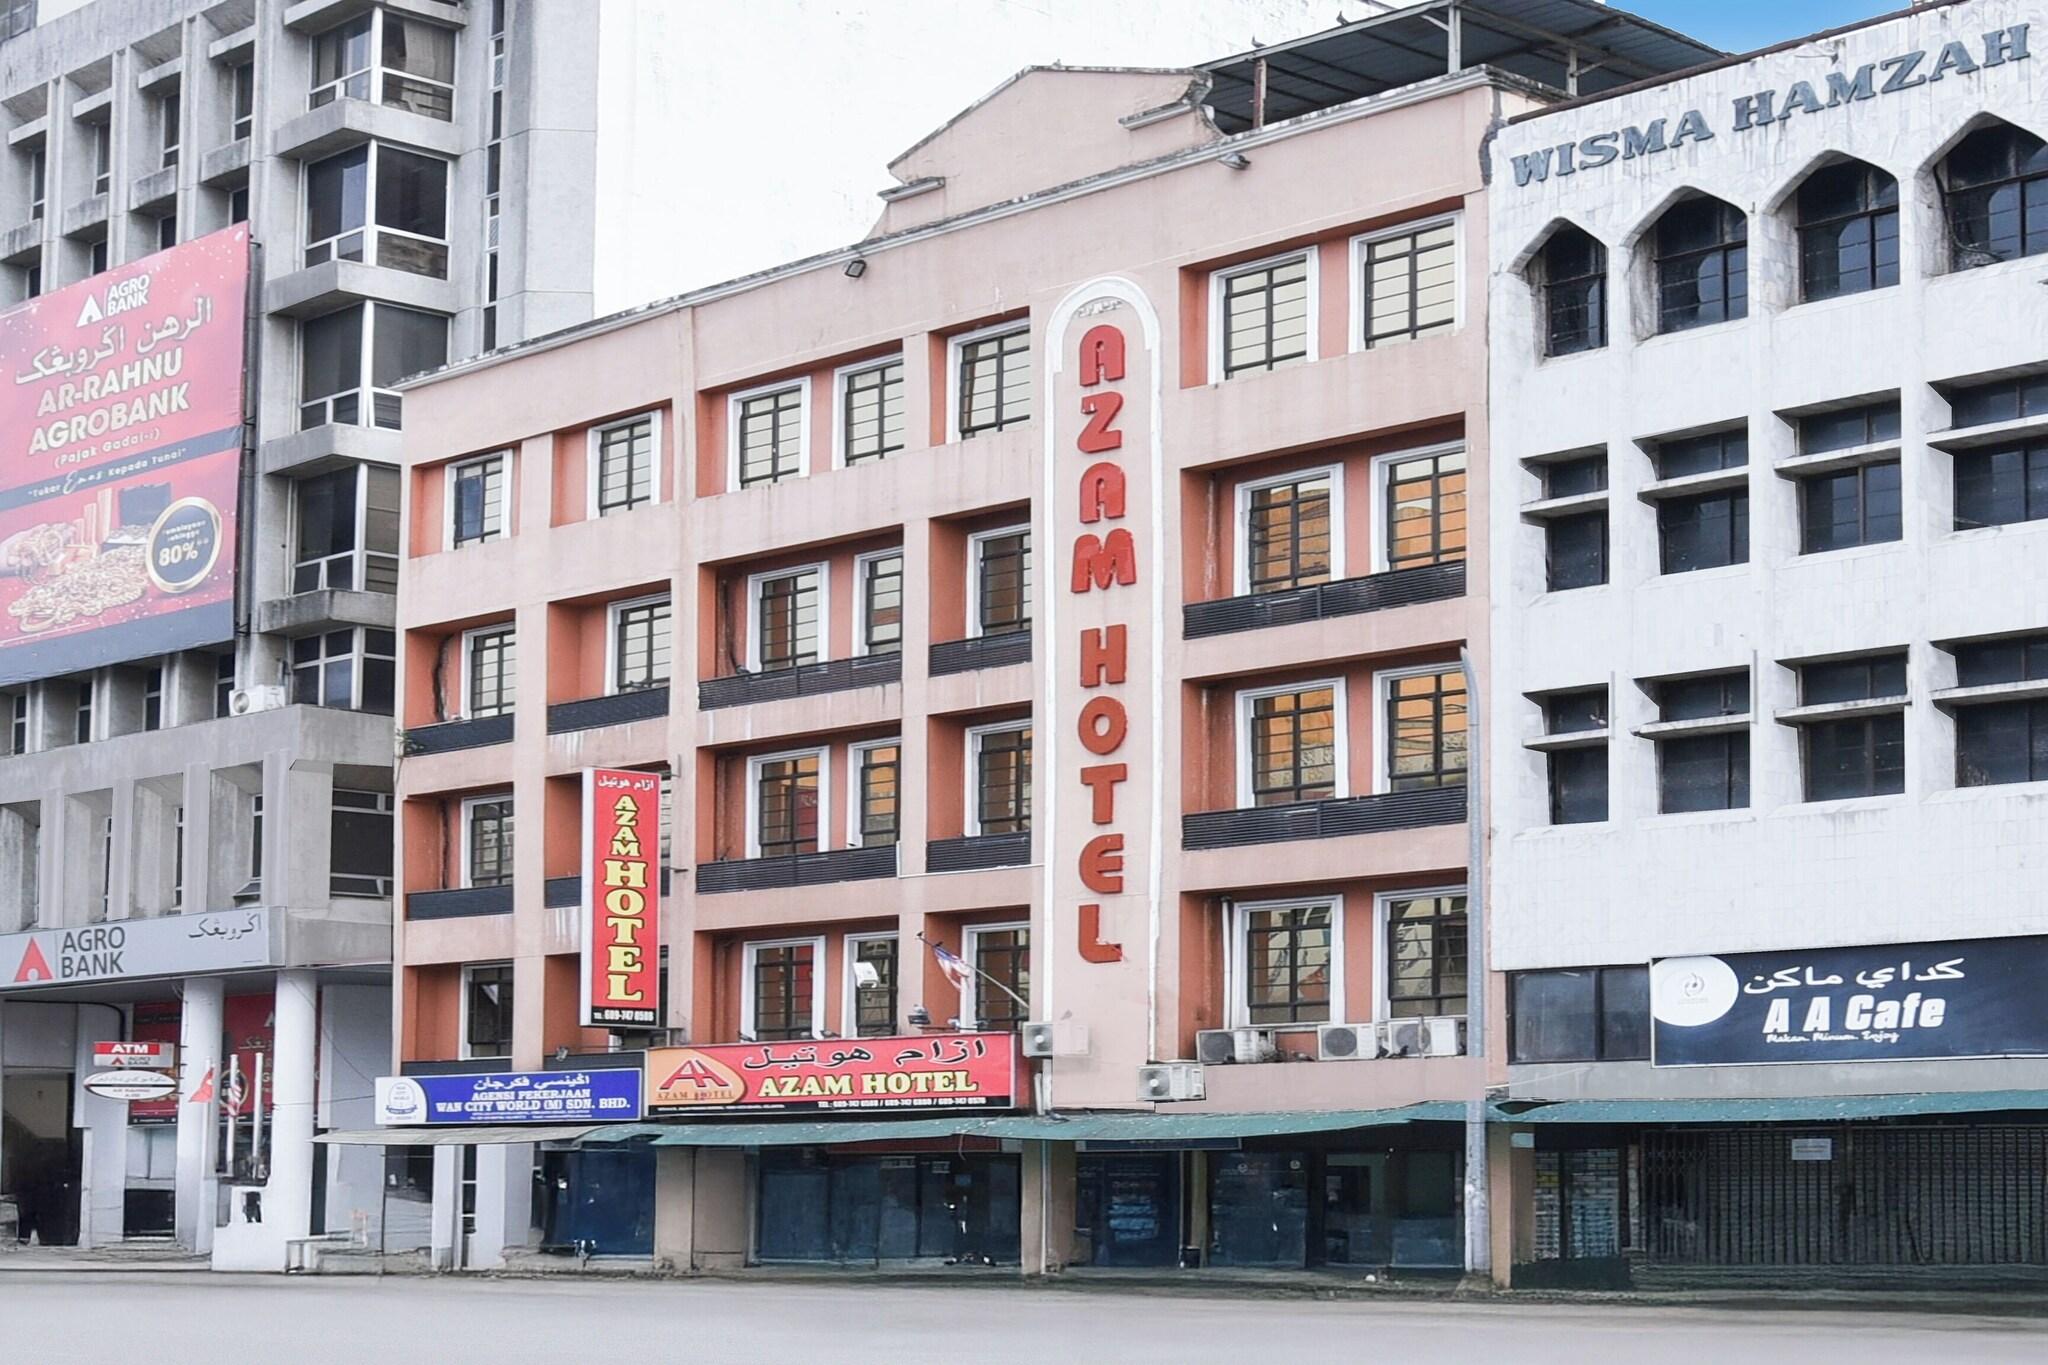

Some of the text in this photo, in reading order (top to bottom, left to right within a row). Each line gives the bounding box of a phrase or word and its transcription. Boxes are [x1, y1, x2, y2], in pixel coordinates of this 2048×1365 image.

[1510, 23, 2031, 187] WISMA HAMZAH
[107, 274, 150, 300] AGRO
[106, 289, 150, 316] BANK
[37, 347, 183, 417] AR-RAHNU
[28, 382, 190, 455] AGROBANK
[1071, 324, 1137, 593] AZAM
[1078, 624, 1127, 963] HOTEL
[604, 794, 648, 1001] AZAM HOTEL
[62, 926, 126, 953] AGRO
[61, 952, 124, 979] BANK
[1763, 992, 1946, 1033] A A Cafe
[111, 1044, 149, 1054] ATM
[744, 1038, 985, 1069] ازام هوتيل
[472, 1089, 591, 1101] AGENSI PEKERJAAN
[757, 1070, 977, 1097] AZAM HOTEL
[436, 1098, 631, 1112] WAN CITY WORLD (M) SDN. BHD.
